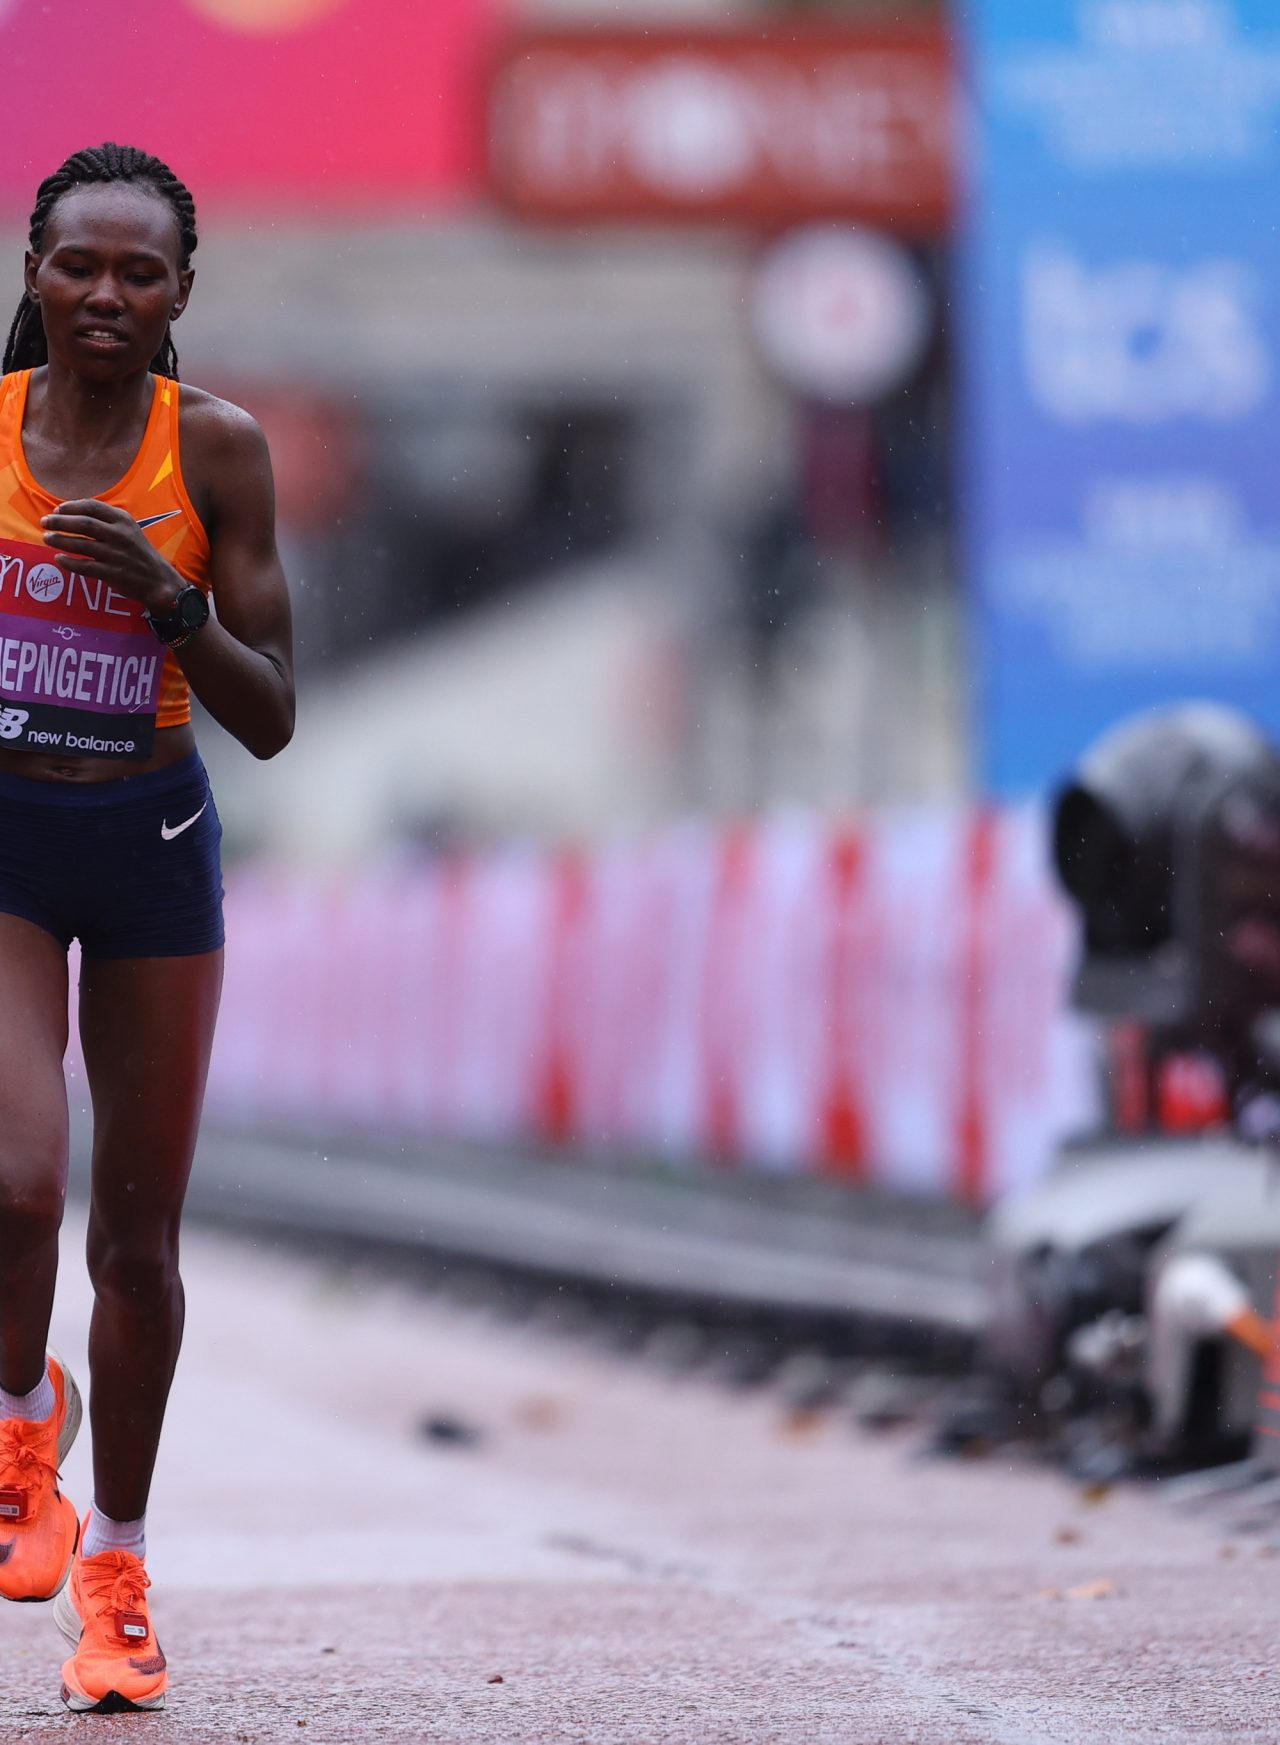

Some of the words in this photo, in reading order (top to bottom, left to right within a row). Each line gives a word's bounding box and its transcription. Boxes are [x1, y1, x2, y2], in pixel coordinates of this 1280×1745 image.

[29, 568, 61, 597] Virgin
[27, 729, 63, 745] new
[65, 732, 135, 753] balance
